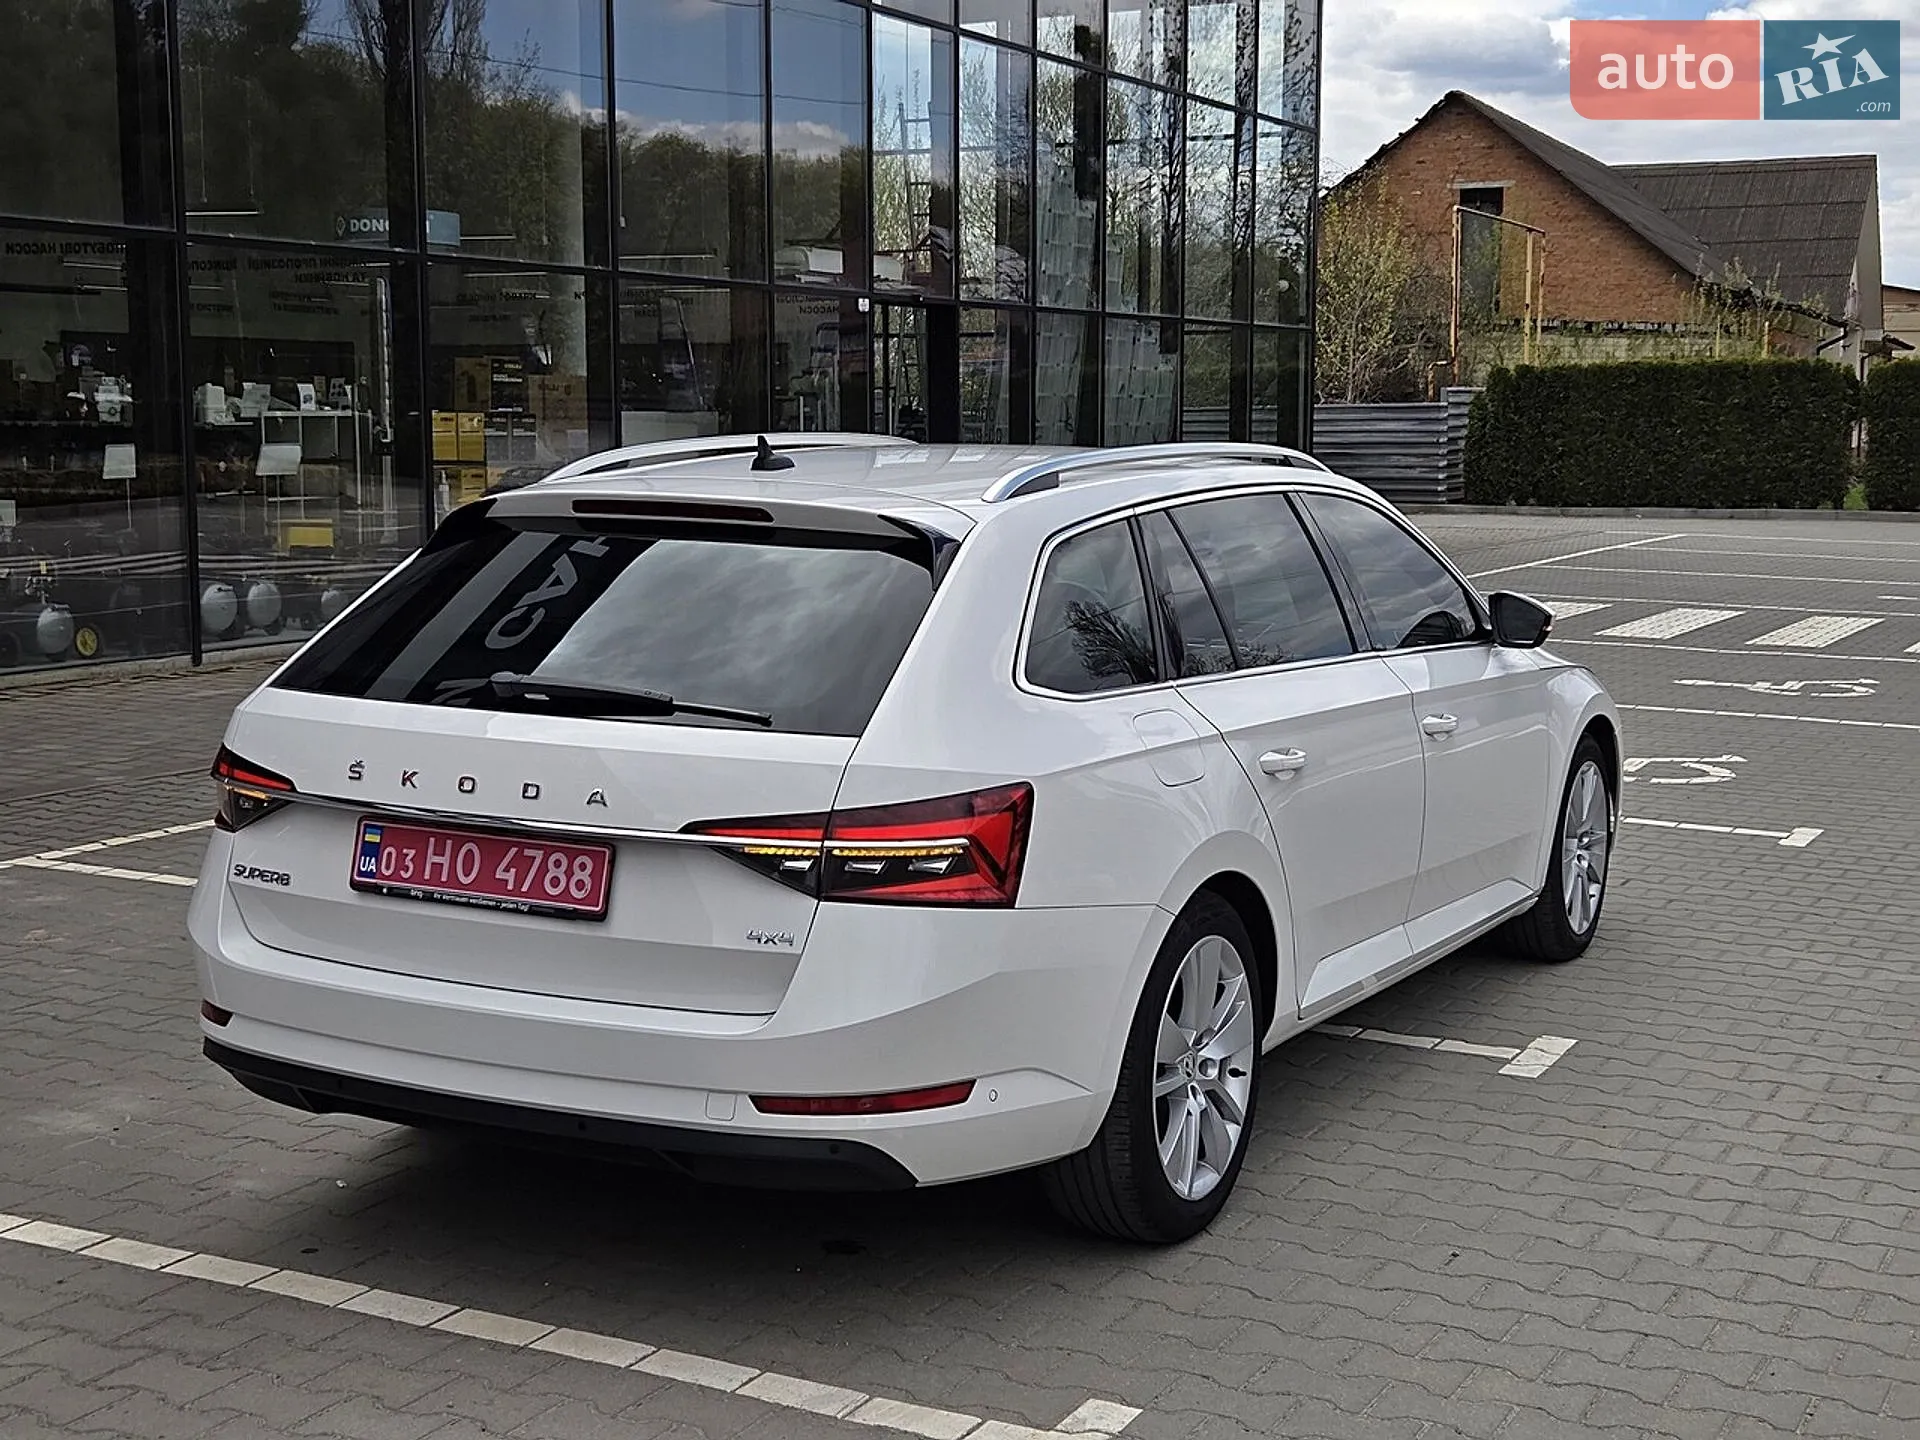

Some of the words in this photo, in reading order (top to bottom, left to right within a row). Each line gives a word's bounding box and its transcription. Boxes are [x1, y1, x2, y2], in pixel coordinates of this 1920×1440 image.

[350, 218, 390, 233] DON
[348, 760, 608, 807] ŠKODA
[233, 864, 291, 886] SUPERB
[360, 856, 377, 872] UA
[380, 846, 416, 879] 03
[424, 837, 482, 885] HO
[495, 847, 594, 899] 4788
